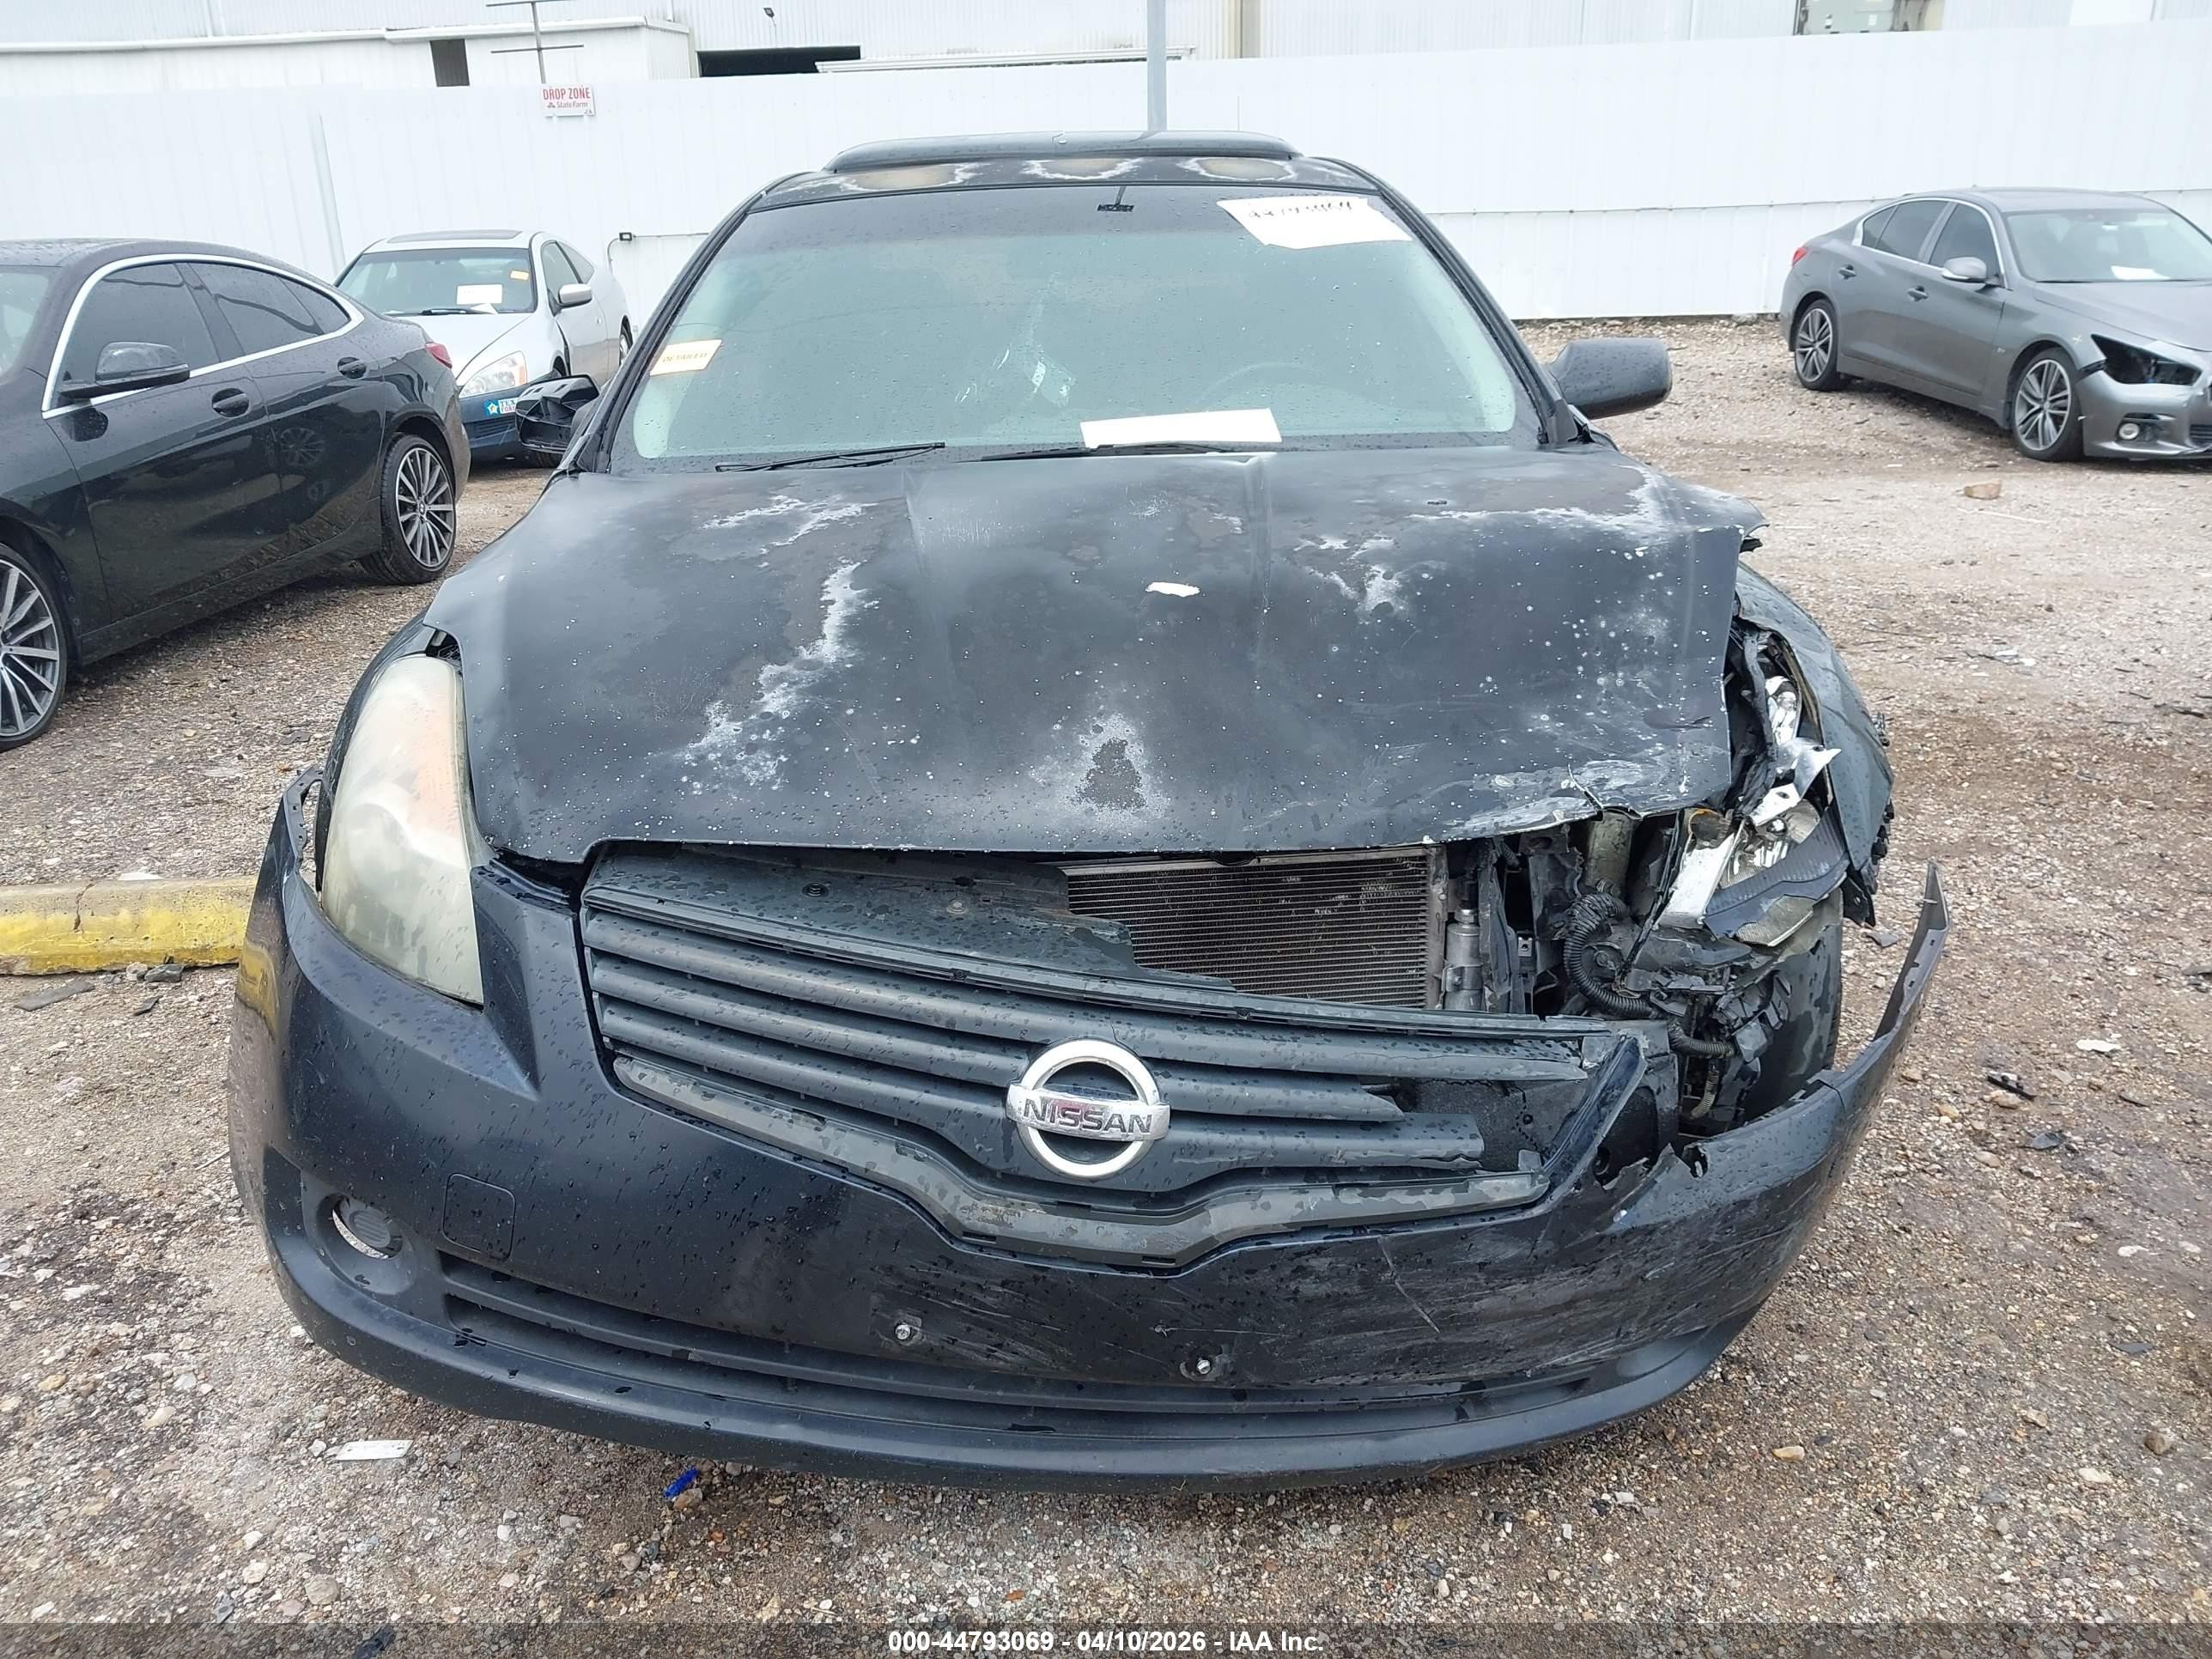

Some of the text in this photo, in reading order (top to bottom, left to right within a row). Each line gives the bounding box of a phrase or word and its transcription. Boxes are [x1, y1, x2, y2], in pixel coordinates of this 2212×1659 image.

[543, 87, 591, 100] DROP ZONE
[1023, 1097, 1153, 1133] NISSAN
